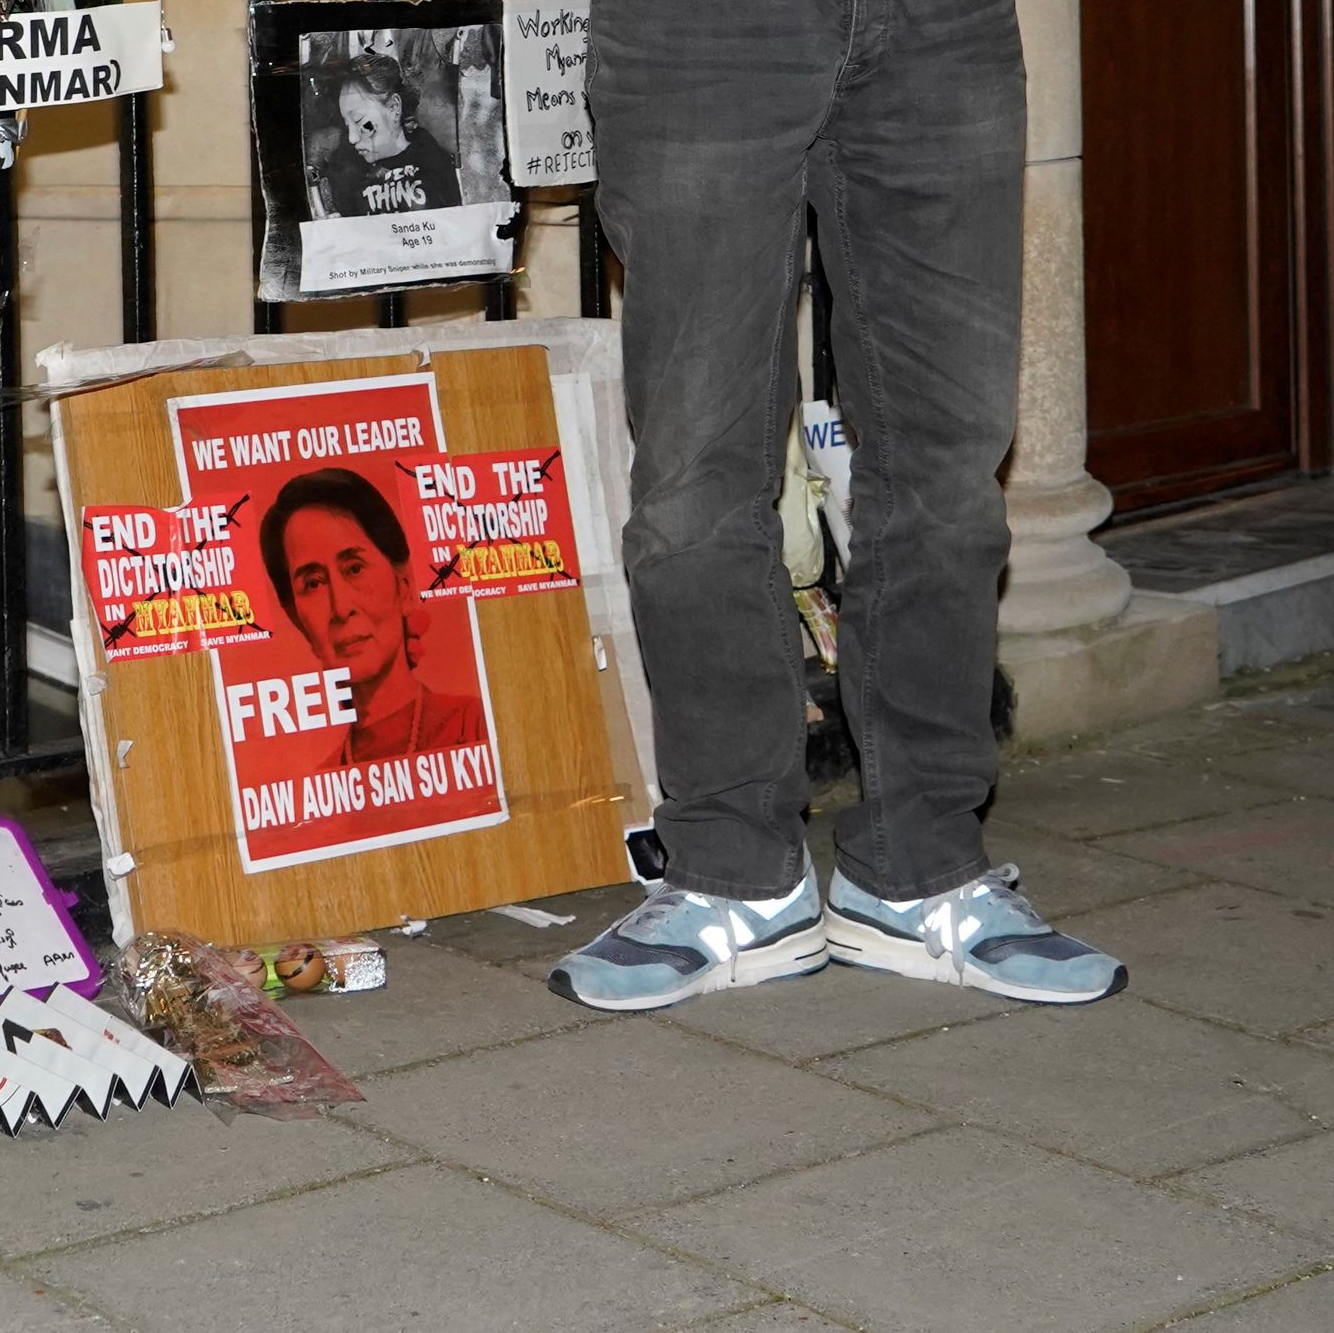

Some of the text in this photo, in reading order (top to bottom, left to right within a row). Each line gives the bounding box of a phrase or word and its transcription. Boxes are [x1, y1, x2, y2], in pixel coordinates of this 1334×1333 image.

[526, 86, 576, 113] Means
[561, 130, 583, 150] on
[362, 179, 427, 212] THING
[391, 221, 436, 235] Sanda Ku
[402, 234, 434, 250] Age 19
[329, 269, 348, 280] Shot
[349, 268, 359, 279] by
[360, 265, 387, 277] Military
[388, 264, 410, 274] Sniper
[430, 260, 444, 269] she
[445, 259, 458, 267] was
[192, 416, 424, 472] WE WANT OUR LEADER
[804, 420, 845, 451] WE
[415, 459, 544, 501] END THE
[91, 504, 232, 553] END THE
[422, 498, 548, 543] DICTATORSHIP
[97, 546, 235, 599] DICTATORSHIP
[432, 539, 565, 583] IN MYANMAR
[420, 589, 434, 600] WE
[435, 586, 457, 598] WANT
[518, 582, 538, 594] SAVE
[539, 578, 578, 591] MYANMAR
[104, 589, 255, 637] IN MYANMAR
[133, 640, 189, 657] DEMOCRACY
[200, 636, 224, 648] SAVE
[226, 630, 271, 644] MYANMAR
[226, 666, 358, 743] FREE
[242, 744, 494, 832] DAW AUNG SAN SU KYI
